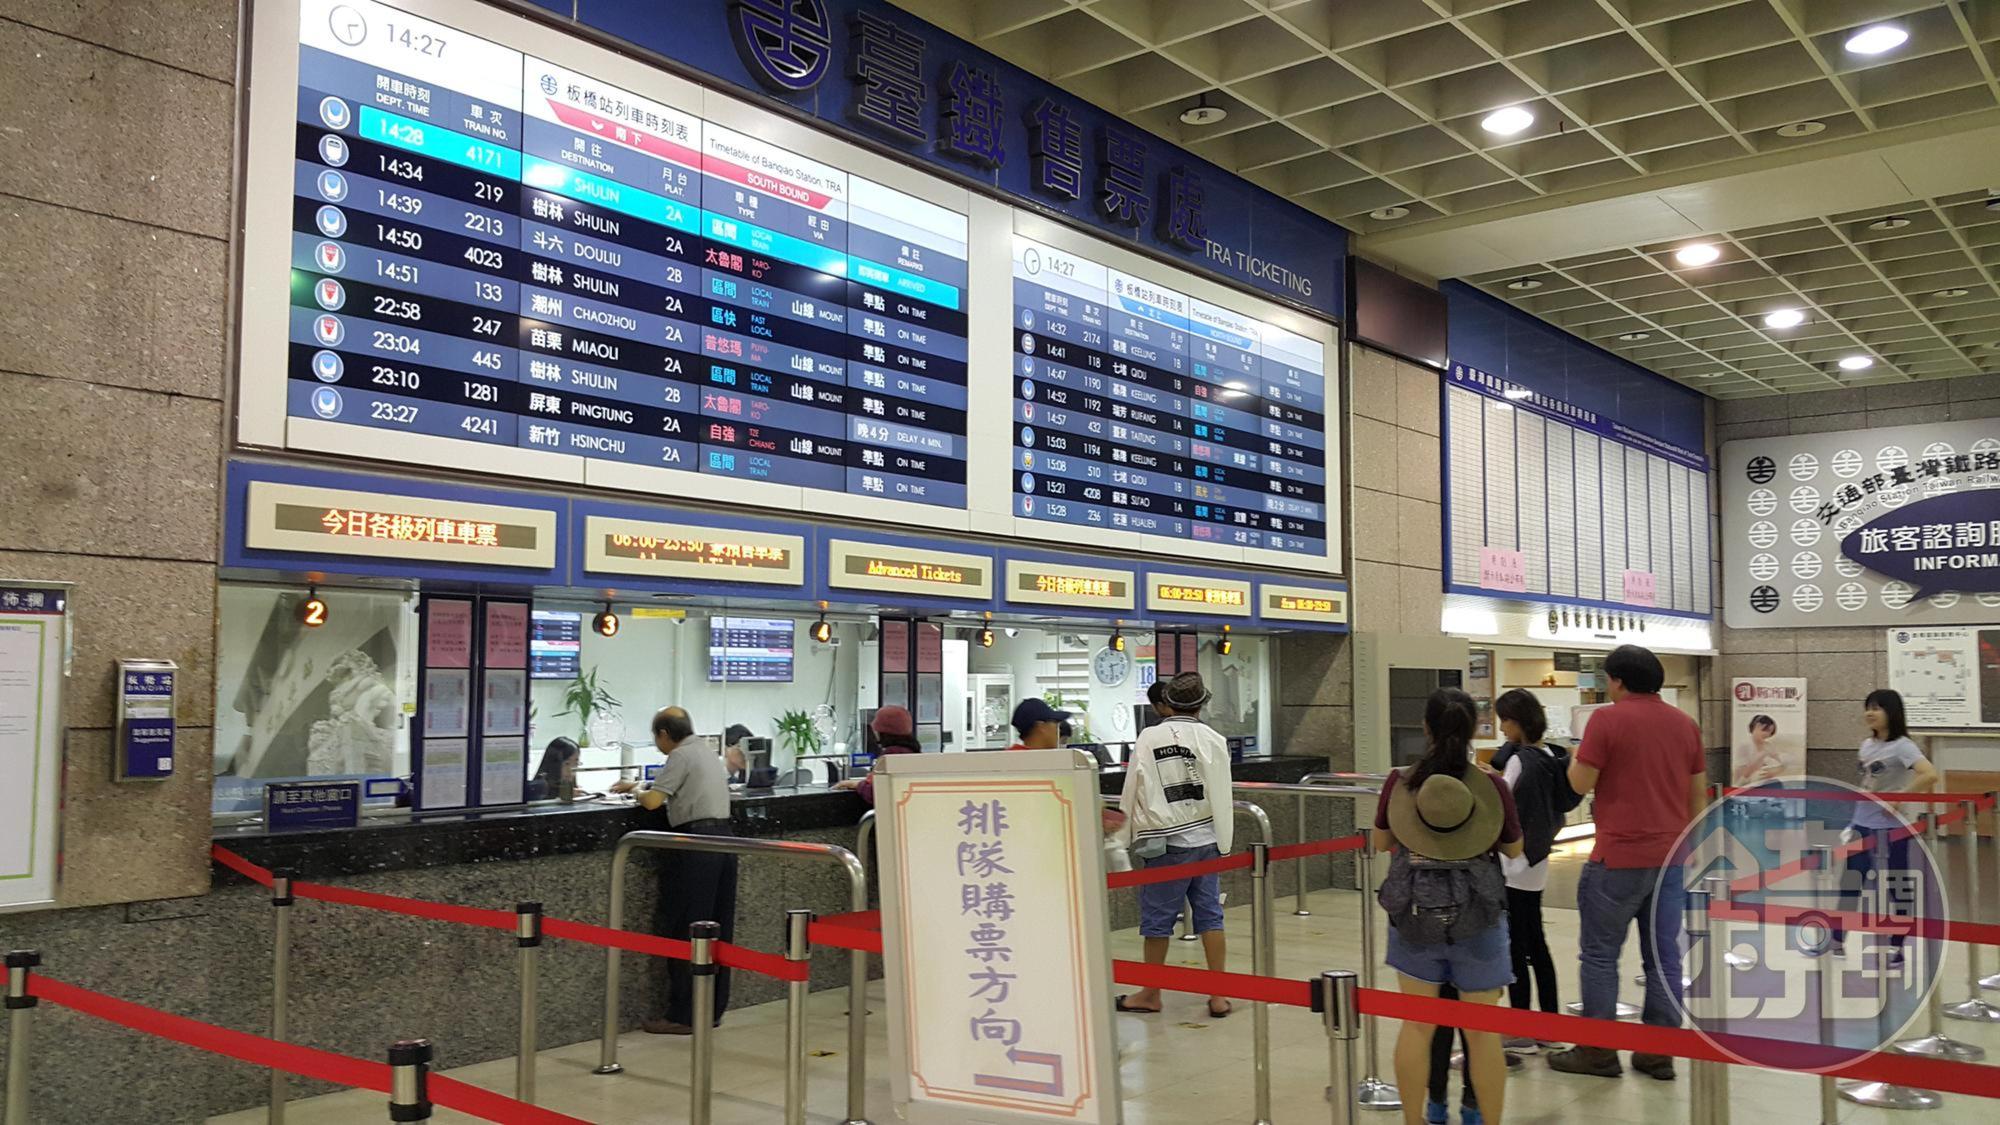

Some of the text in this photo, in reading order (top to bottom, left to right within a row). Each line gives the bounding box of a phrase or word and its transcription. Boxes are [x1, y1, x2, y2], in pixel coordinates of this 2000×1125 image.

[387, 23, 447, 59] 14:27
[375, 74, 431, 104] 開車時刻
[375, 93, 430, 118] DEPT. TIME
[566, 84, 689, 143] 板橋站列車時刻表
[463, 119, 508, 141] TRAIN NO.
[616, 128, 643, 146] 南下
[856, 10, 1208, 249] 臺鐵售票處
[574, 137, 602, 159] 開往
[379, 118, 425, 146] 14:28
[466, 146, 502, 168] 4171
[574, 177, 620, 204] SHULIN
[665, 205, 684, 222] 2A
[561, 149, 614, 175] DESTINATION
[710, 137, 750, 166] Timetable
[752, 152, 760, 165] of
[761, 155, 794, 181] Banqiao
[824, 178, 842, 194] TRA
[662, 167, 687, 187] 月台
[747, 173, 810, 203] SOUTH BOUND
[664, 183, 685, 199] PLAT.
[378, 155, 423, 183] 14:34
[474, 182, 503, 203] 219
[532, 197, 564, 221] 樹林
[574, 209, 620, 237] SHULIN
[665, 237, 684, 255] 2A
[705, 247, 743, 272] 太魯閣
[738, 206, 756, 220] TYPE
[812, 230, 826, 241] VIA
[377, 189, 844, 324] 14:39 2213 斗六 DOULIU 2B 區間 山線 MOUNT
[1047, 257, 1075, 277] 14:27
[1203, 237, 1312, 297] TRA TICKETING
[377, 224, 738, 328] 14:50 4023 樹林 SHULIN 2A 區快
[376, 259, 843, 377] 14:51 133 潮州 CHAOZHOU 2A 普悠瑪 山線 MOUNT
[1047, 320, 1067, 336] 14:32
[1083, 331, 1101, 345] 2174
[374, 296, 843, 405] 22:58 247 苗栗 MIAOLI 2A 區間 山線 MOUNT
[1047, 344, 1066, 359] 14:41
[1088, 355, 1101, 368] 118
[373, 330, 420, 356] 23:04
[472, 350, 502, 371] 445
[530, 360, 562, 383] 樹林
[571, 368, 618, 392] SHULIN
[664, 387, 681, 403] 2B
[704, 393, 742, 416] 太魯閣
[897, 431, 919, 444] DELAY
[920, 434, 927, 444] 4
[928, 437, 943, 448] MIN.
[1047, 367, 1067, 381] 14:47
[1084, 376, 1101, 389] 1190
[372, 366, 842, 457] 23:10 1281 屏東 PINGTUNG 2A 自強 山線 MOUNT
[1047, 389, 1067, 404] 14:52
[1084, 398, 1101, 412] 1192
[1047, 412, 1067, 425] 14:57
[1088, 422, 1101, 433] 432
[371, 400, 735, 472] 23:27 4241 新竹 HSINCHU 2A 區間
[1046, 436, 1067, 450] 15:03
[1084, 443, 1101, 456] 1194
[1088, 466, 1101, 478] 510
[1046, 481, 1066, 494] 15:21
[1839, 474, 2000, 530] Banqiao Station Taiwan Railw
[1088, 510, 1101, 521] 236
[322, 509, 499, 547] 今日各級列車車票
[868, 560, 962, 584] Advanced Tickets
[1914, 553, 2000, 571] INFORM
[306, 601, 323, 624] 2
[604, 616, 617, 637] 3
[818, 623, 829, 641] 4
[984, 631, 994, 647] 5
[1116, 635, 1125, 651] 6
[1223, 642, 1231, 655] 7
[1140, 665, 1155, 685] 18
[957, 799, 1022, 1046] 排隊購票方向
